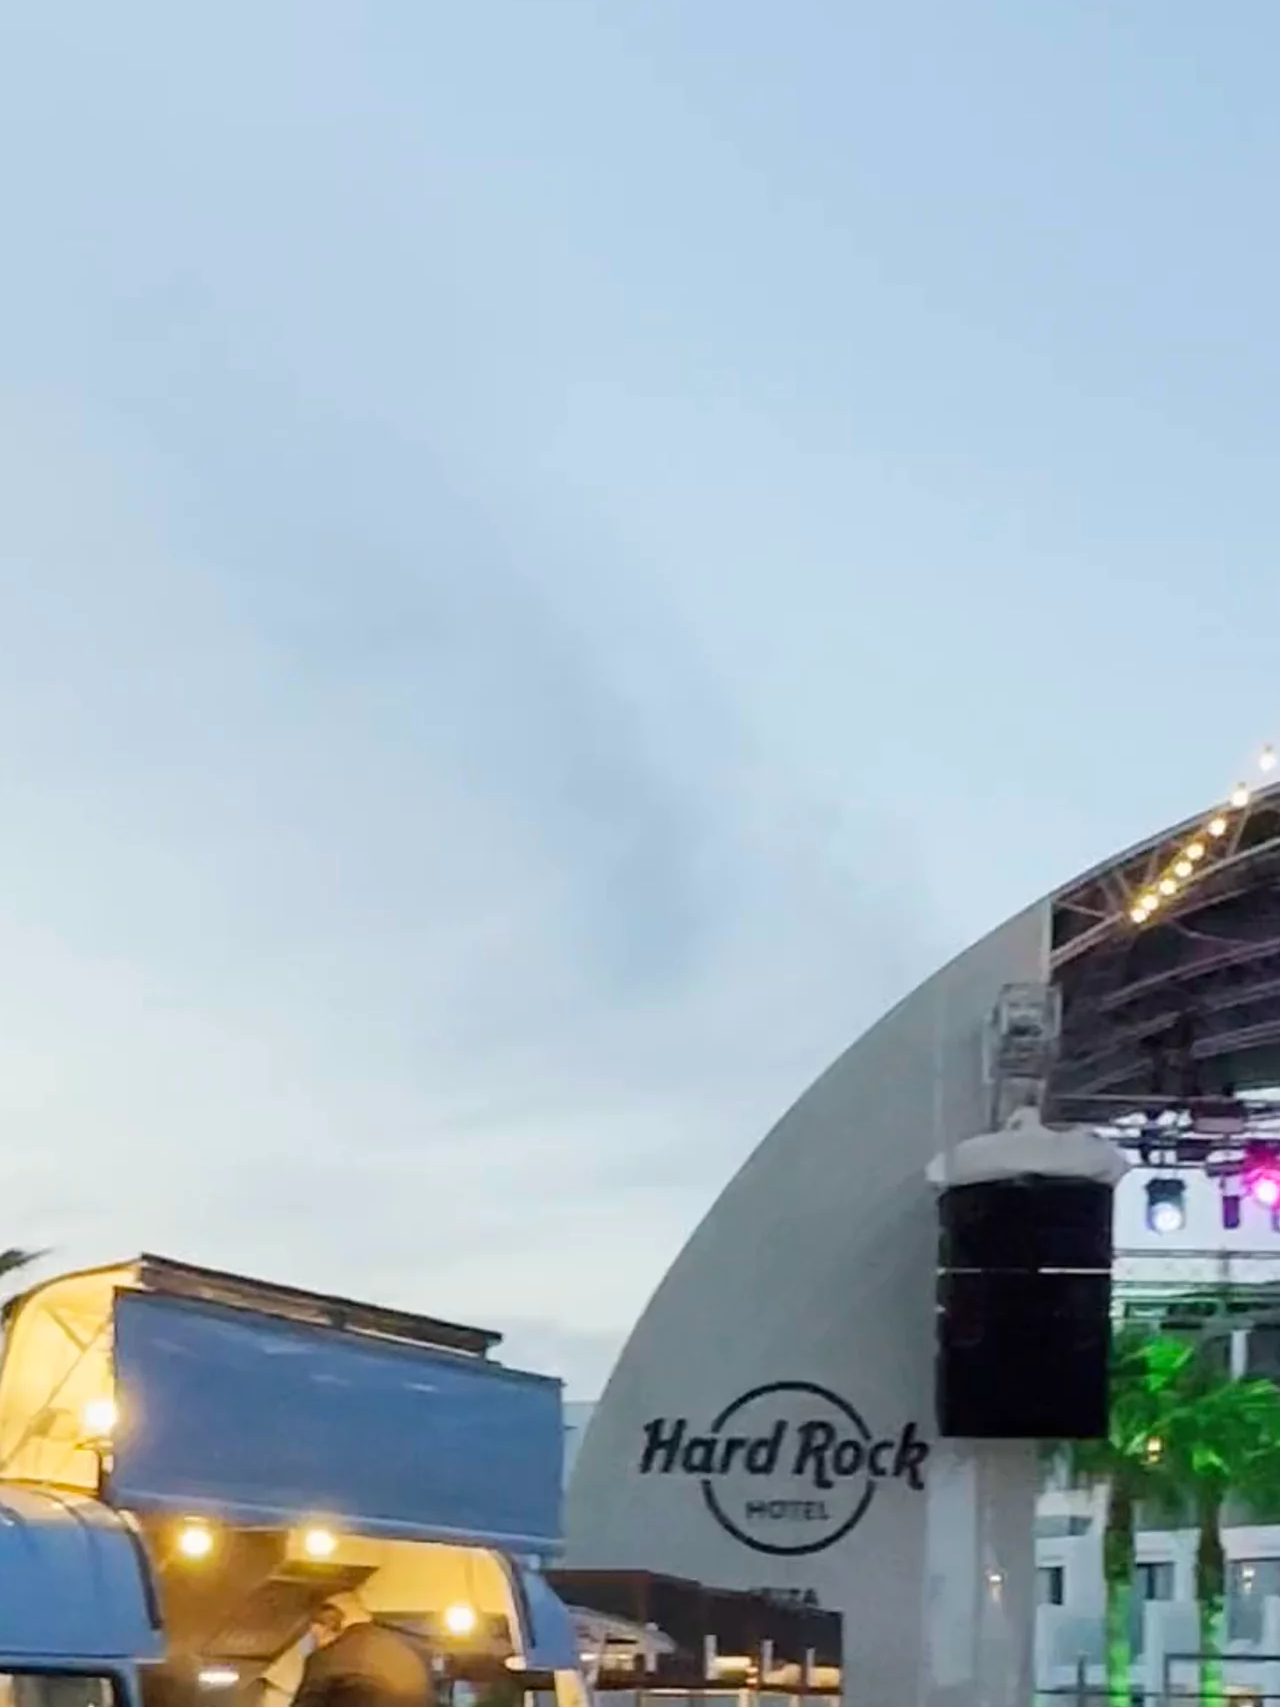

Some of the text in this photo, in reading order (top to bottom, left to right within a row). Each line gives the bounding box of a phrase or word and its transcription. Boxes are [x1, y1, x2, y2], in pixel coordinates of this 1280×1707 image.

[640, 1418, 930, 1491] Hard Rock
[745, 1500, 832, 1522] HOTEL
